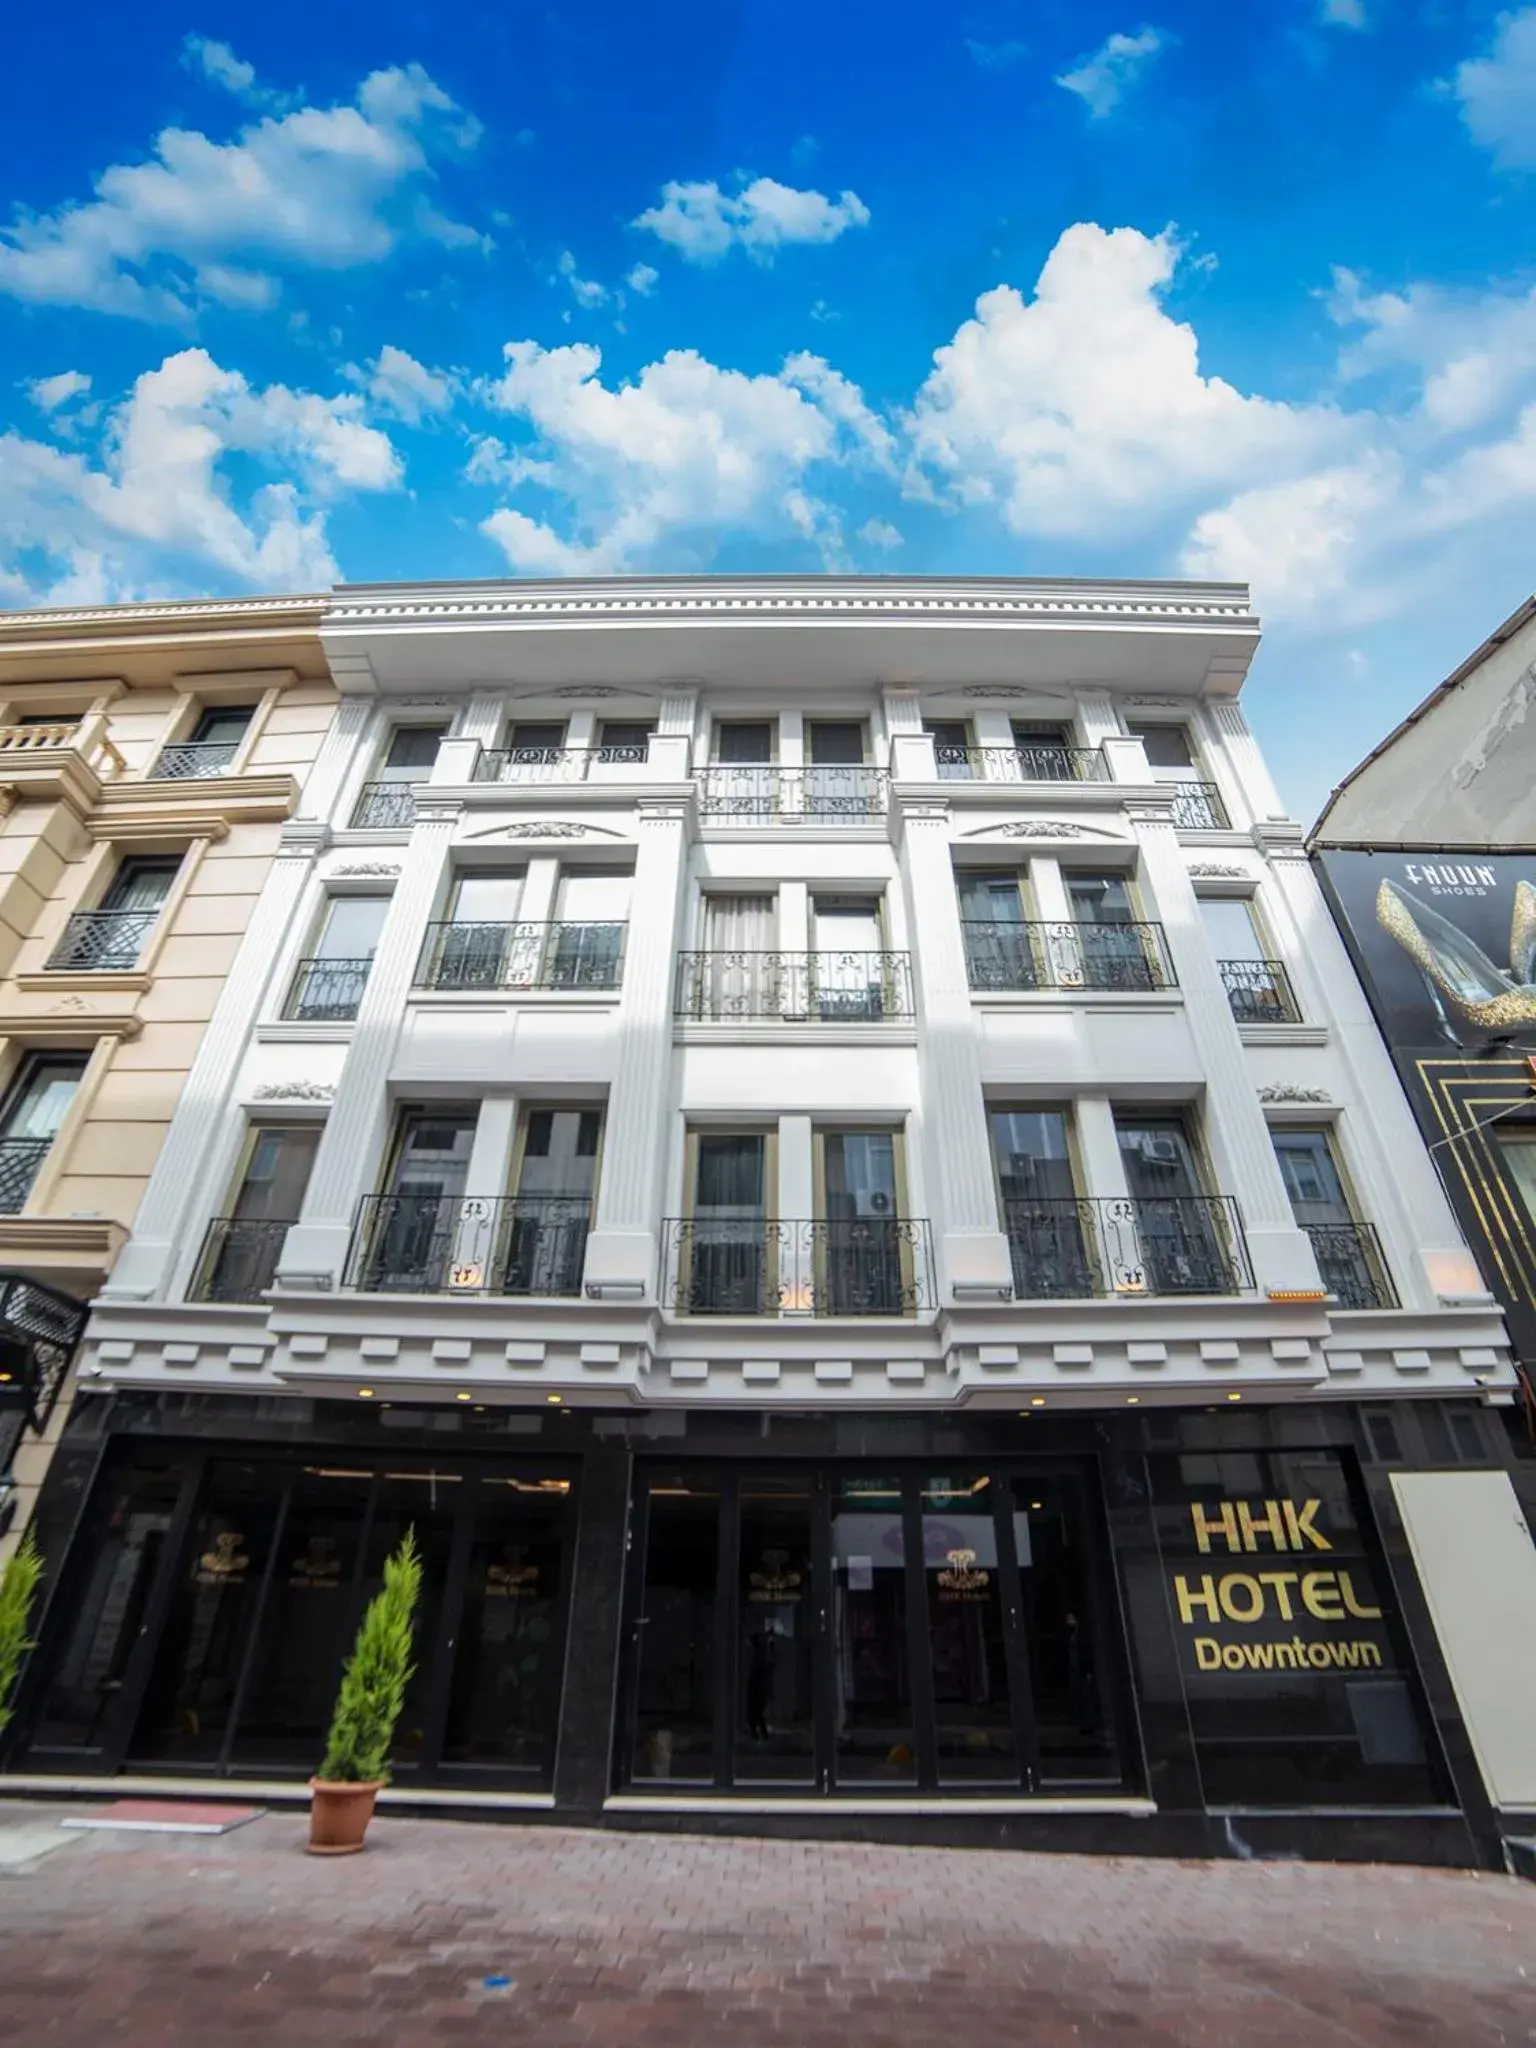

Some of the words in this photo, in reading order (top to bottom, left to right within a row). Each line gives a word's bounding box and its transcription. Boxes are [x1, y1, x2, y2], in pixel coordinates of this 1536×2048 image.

[1431, 886, 1487, 896] SHOES
[1191, 1499, 1333, 1552] HHK
[1174, 1571, 1382, 1624] HOTEL
[1194, 1636, 1382, 1670] Downtown
